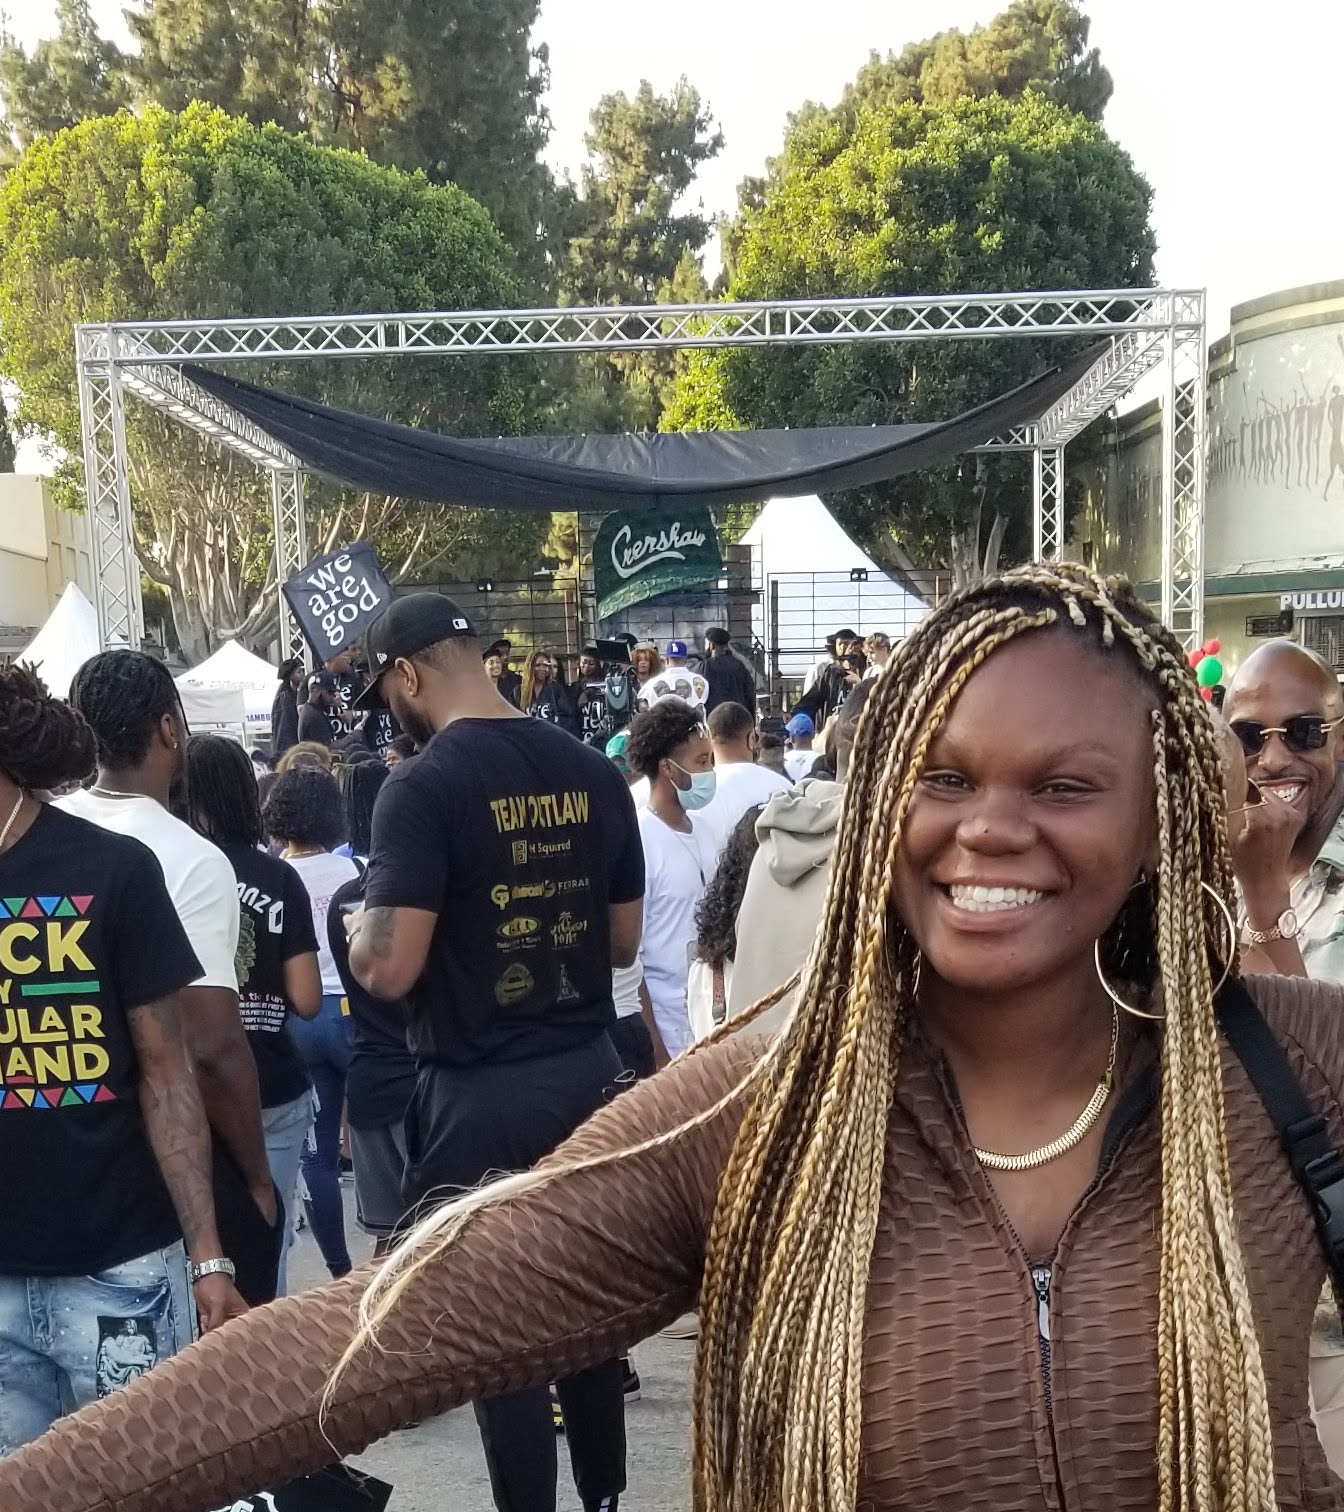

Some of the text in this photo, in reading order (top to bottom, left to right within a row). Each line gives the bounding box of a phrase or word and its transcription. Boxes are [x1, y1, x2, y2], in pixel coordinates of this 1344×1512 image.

[307, 554, 352, 591] we
[308, 575, 360, 616] are
[321, 577, 381, 646] god
